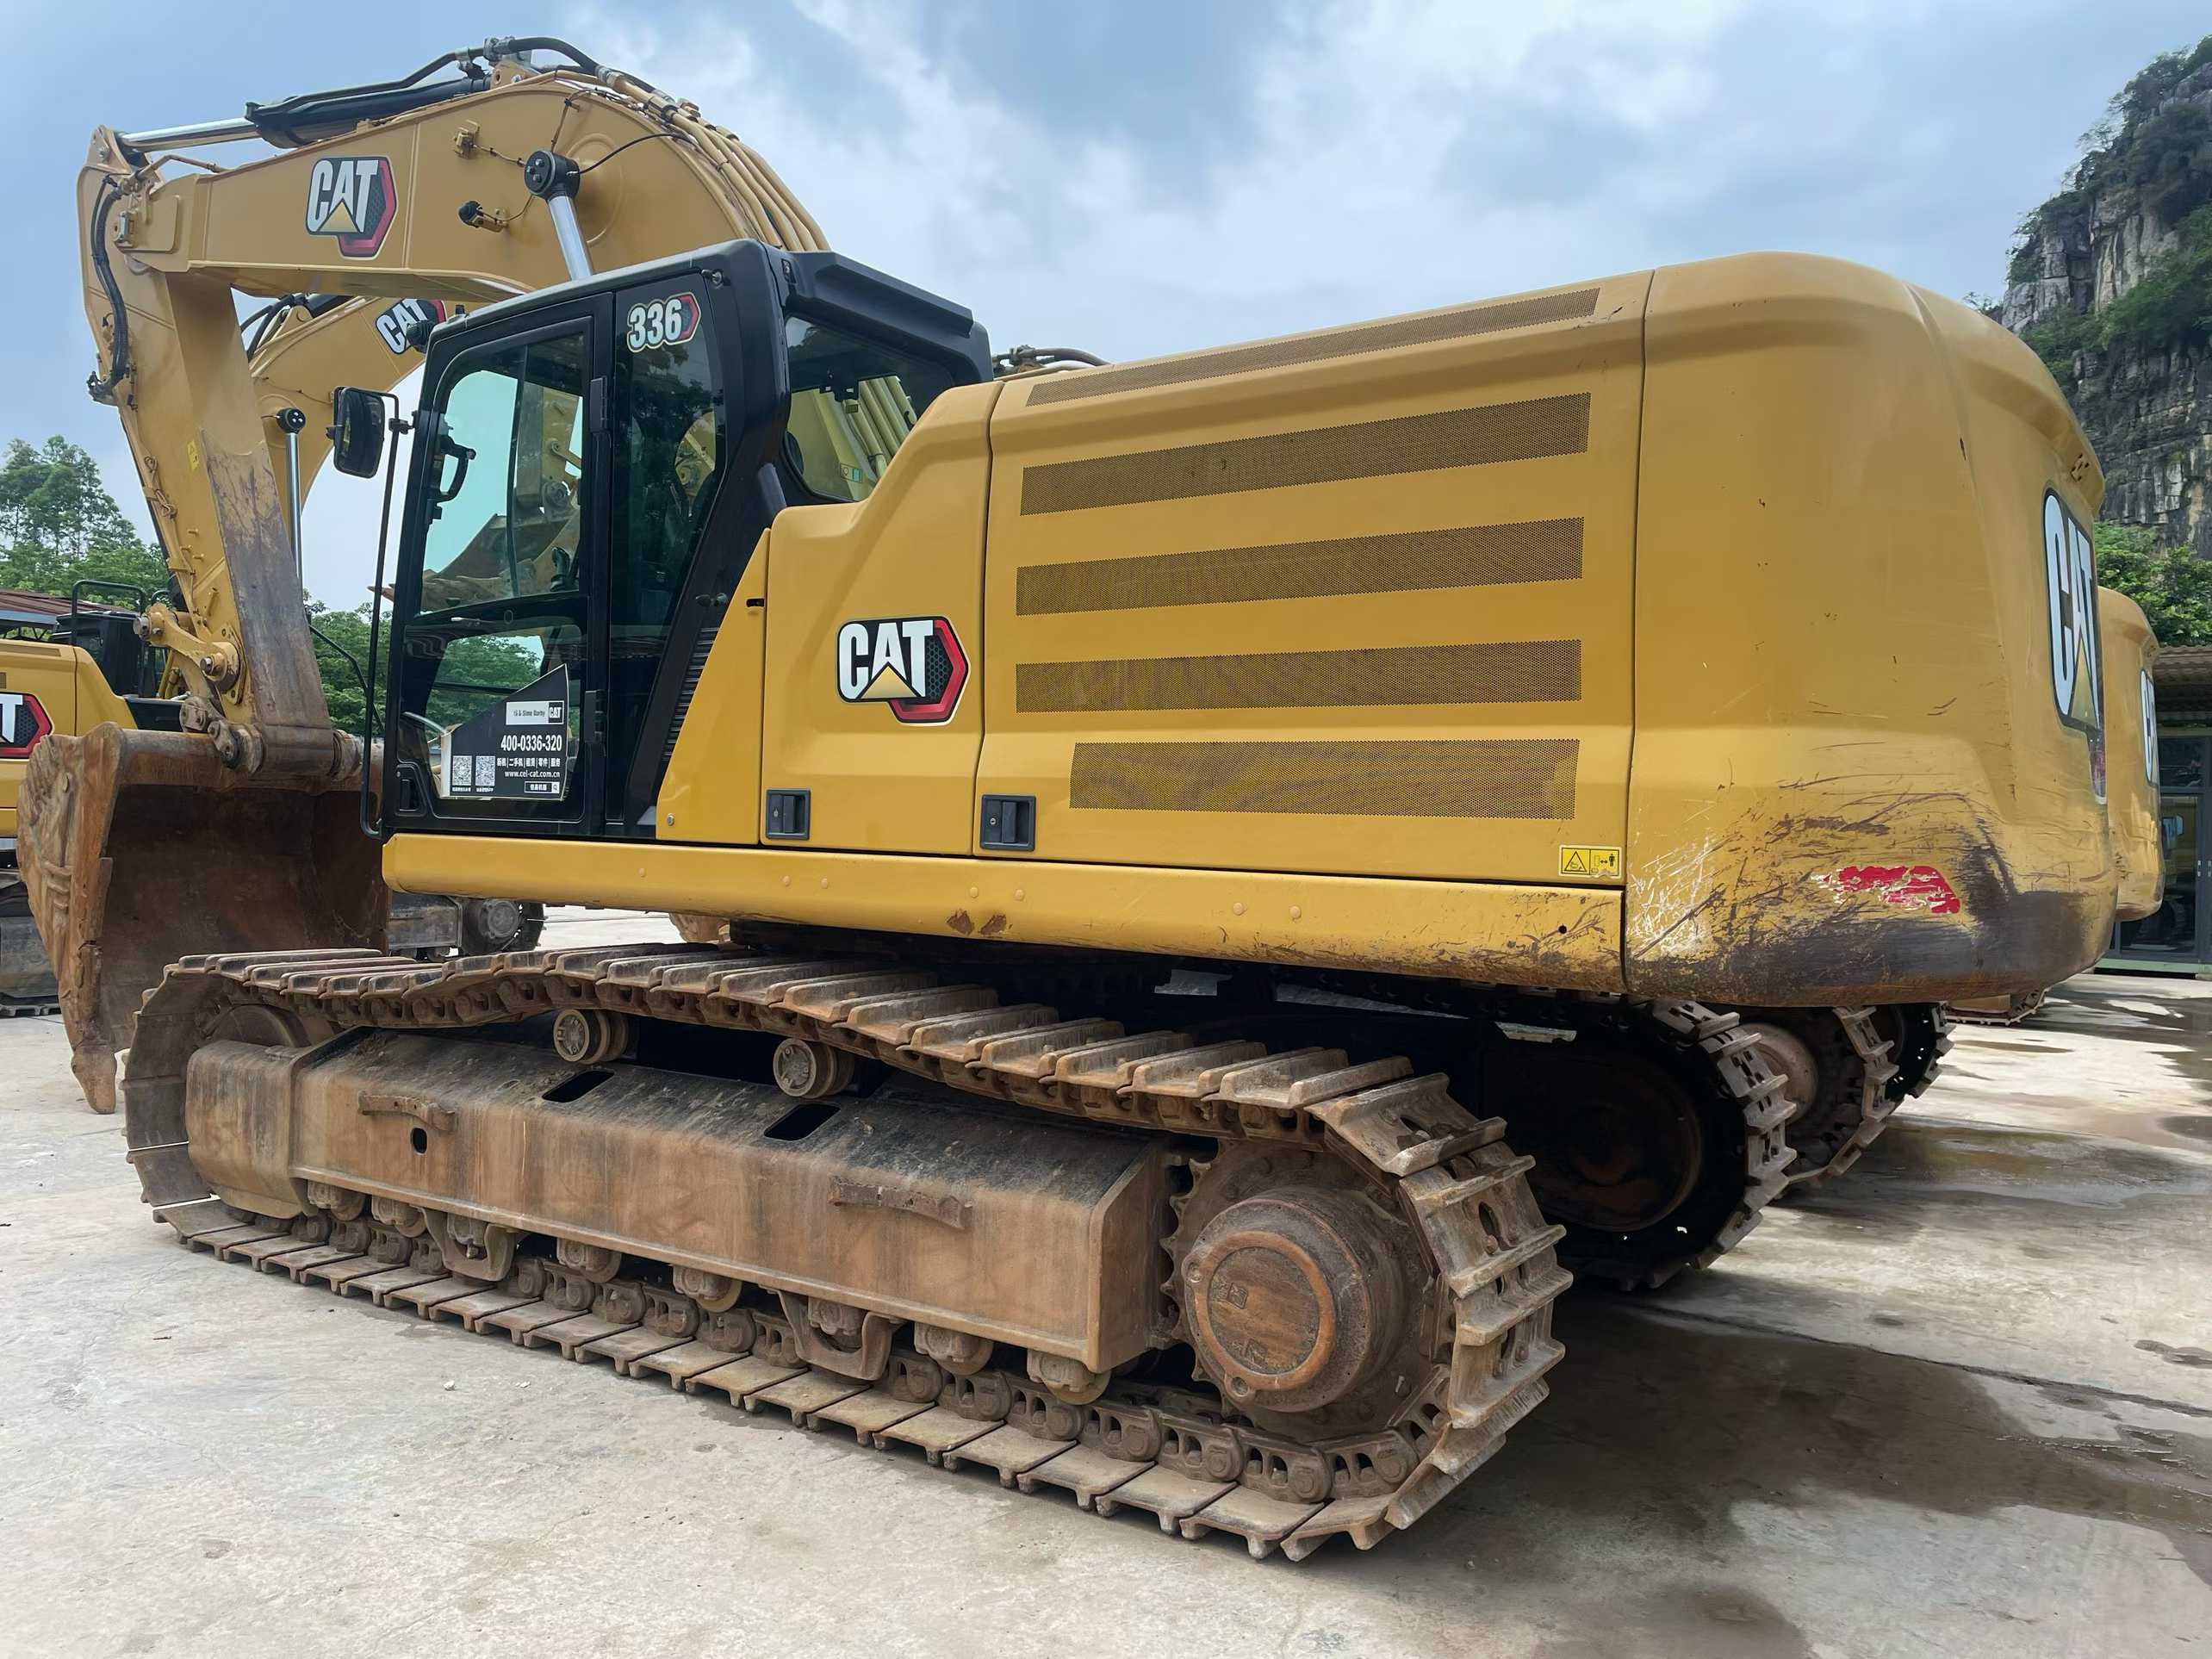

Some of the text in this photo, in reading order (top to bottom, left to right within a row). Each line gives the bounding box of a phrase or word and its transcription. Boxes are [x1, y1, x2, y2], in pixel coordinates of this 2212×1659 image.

[308, 159, 379, 233] CAT
[630, 299, 682, 348] 336
[2045, 495, 2100, 730] CAT
[840, 620, 933, 699] CAT
[500, 735, 562, 751] 400-0336-320
[549, 707, 561, 718] CAT
